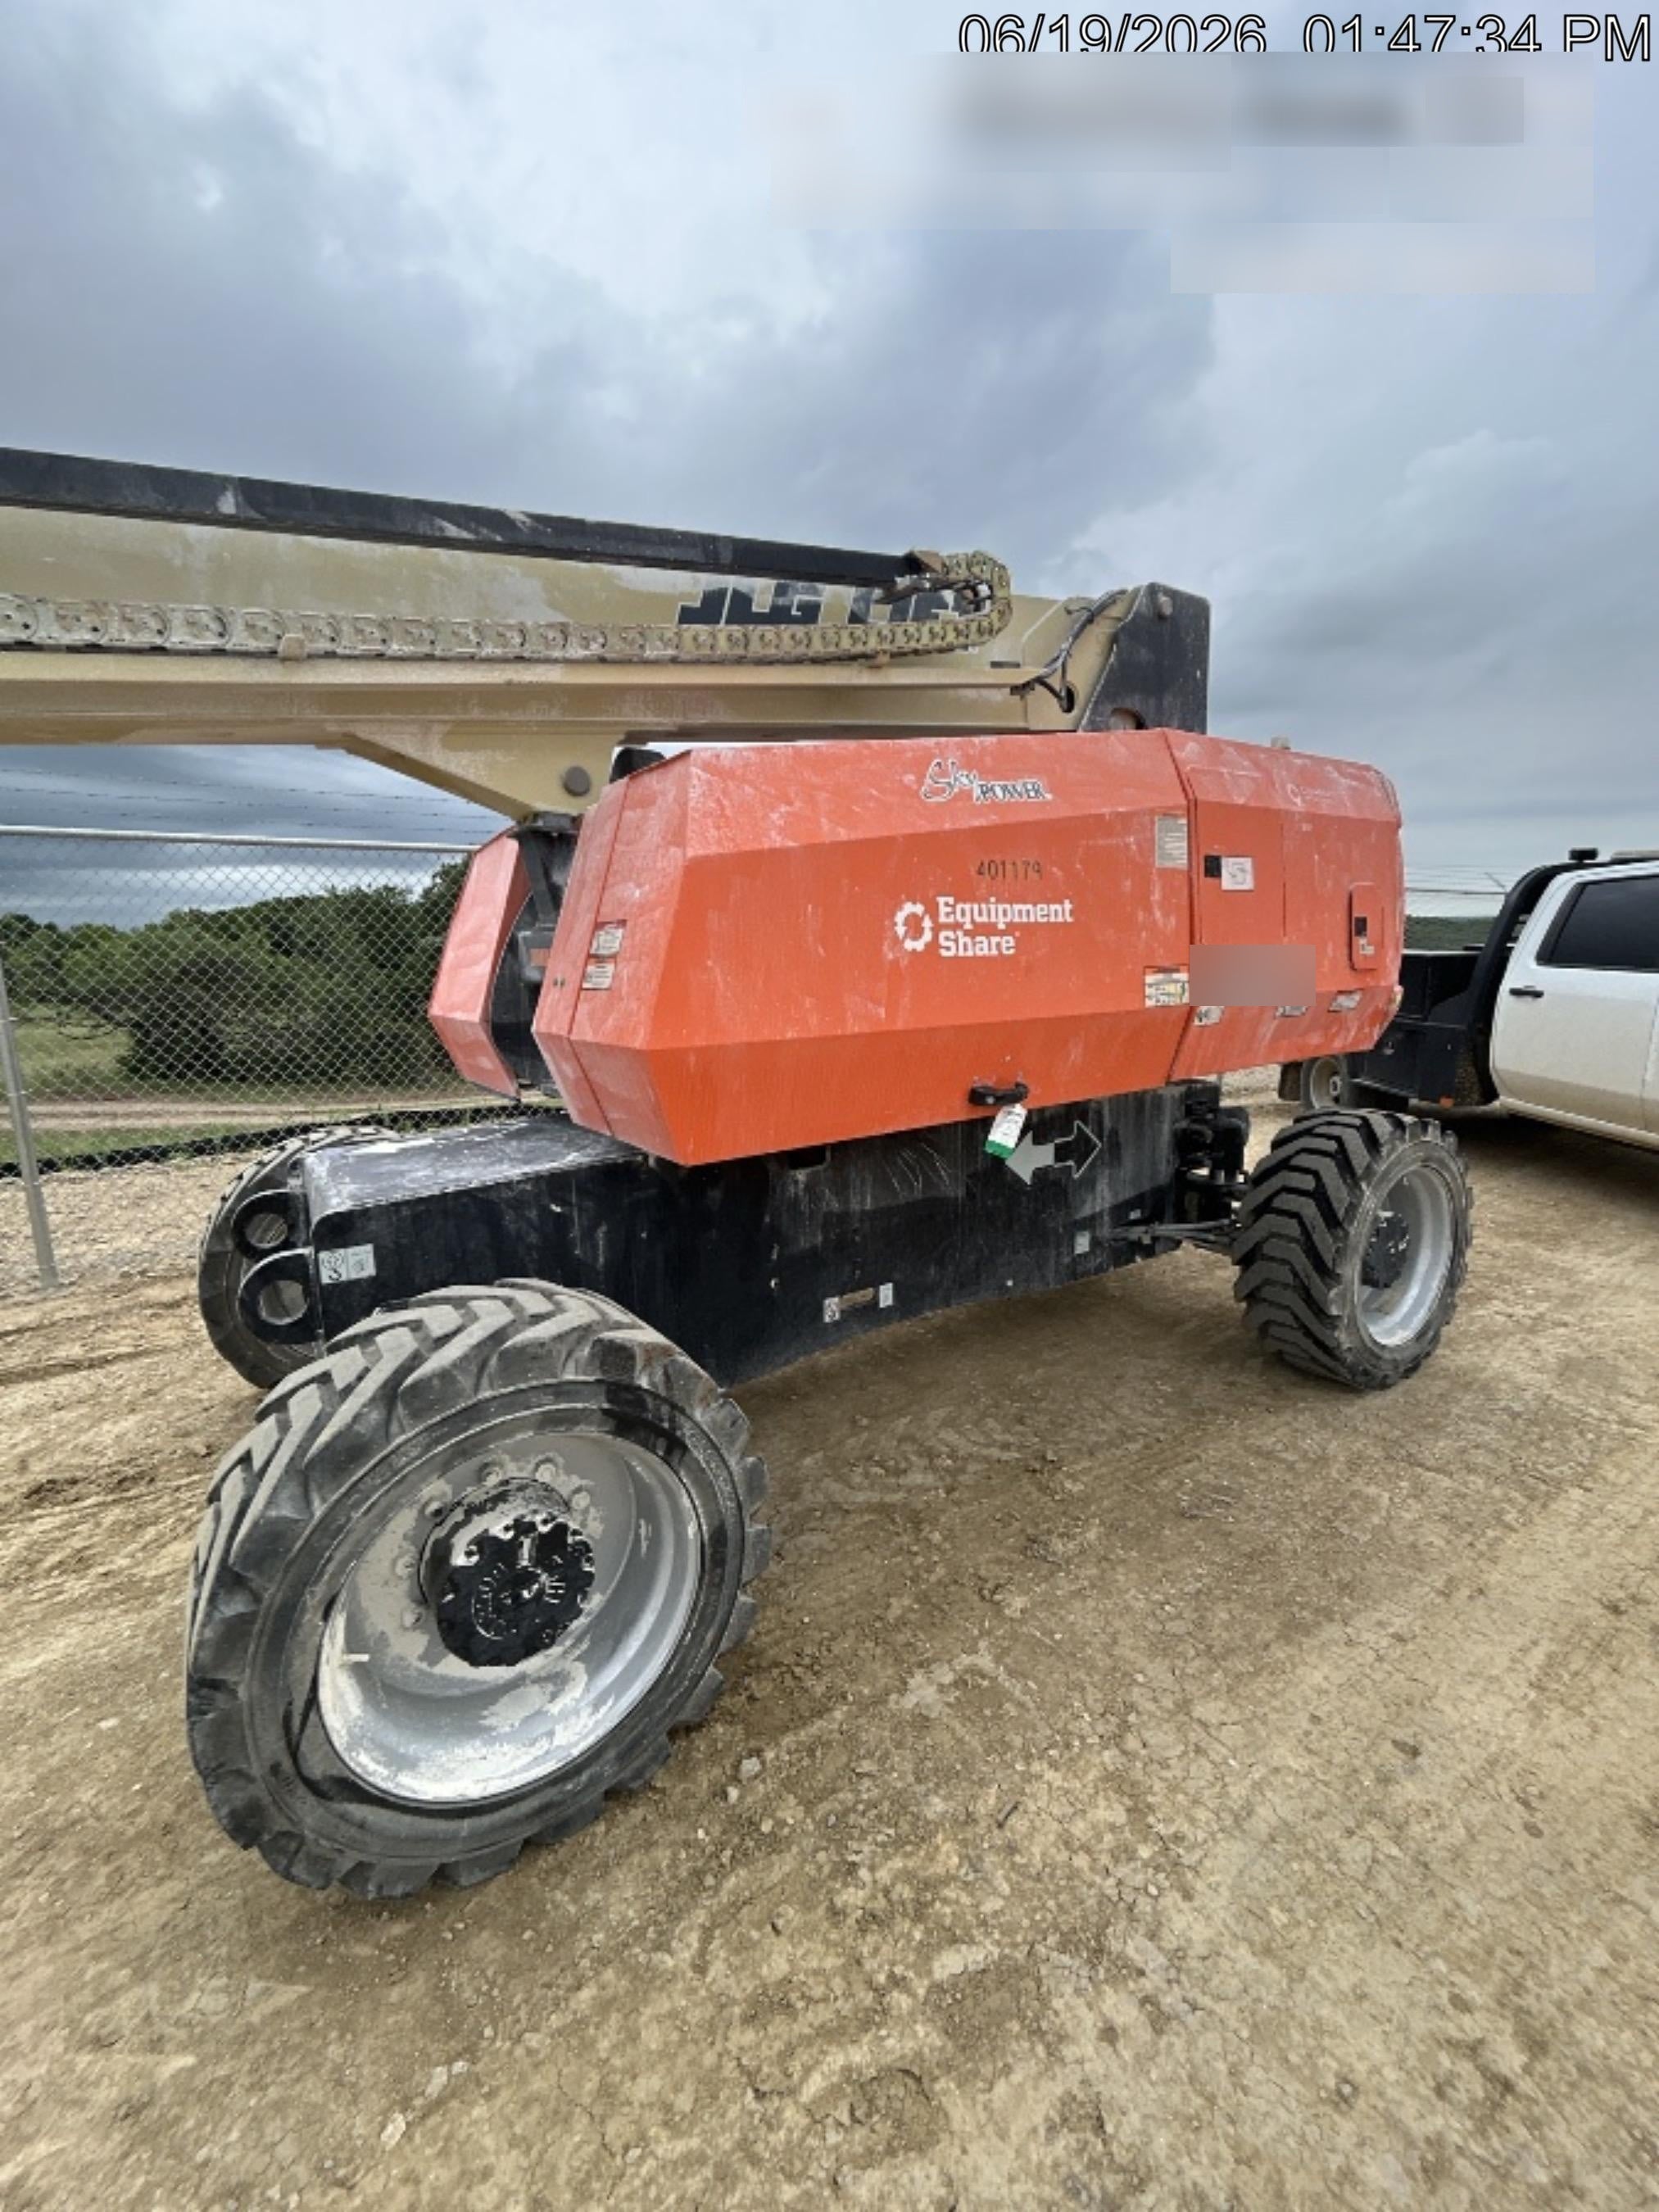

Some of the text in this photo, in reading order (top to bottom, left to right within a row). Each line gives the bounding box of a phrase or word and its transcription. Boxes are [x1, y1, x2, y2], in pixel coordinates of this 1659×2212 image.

[976, 859, 1043, 881] 401179
[936, 896, 1073, 929] Equipment
[939, 931, 1017, 957] Share
